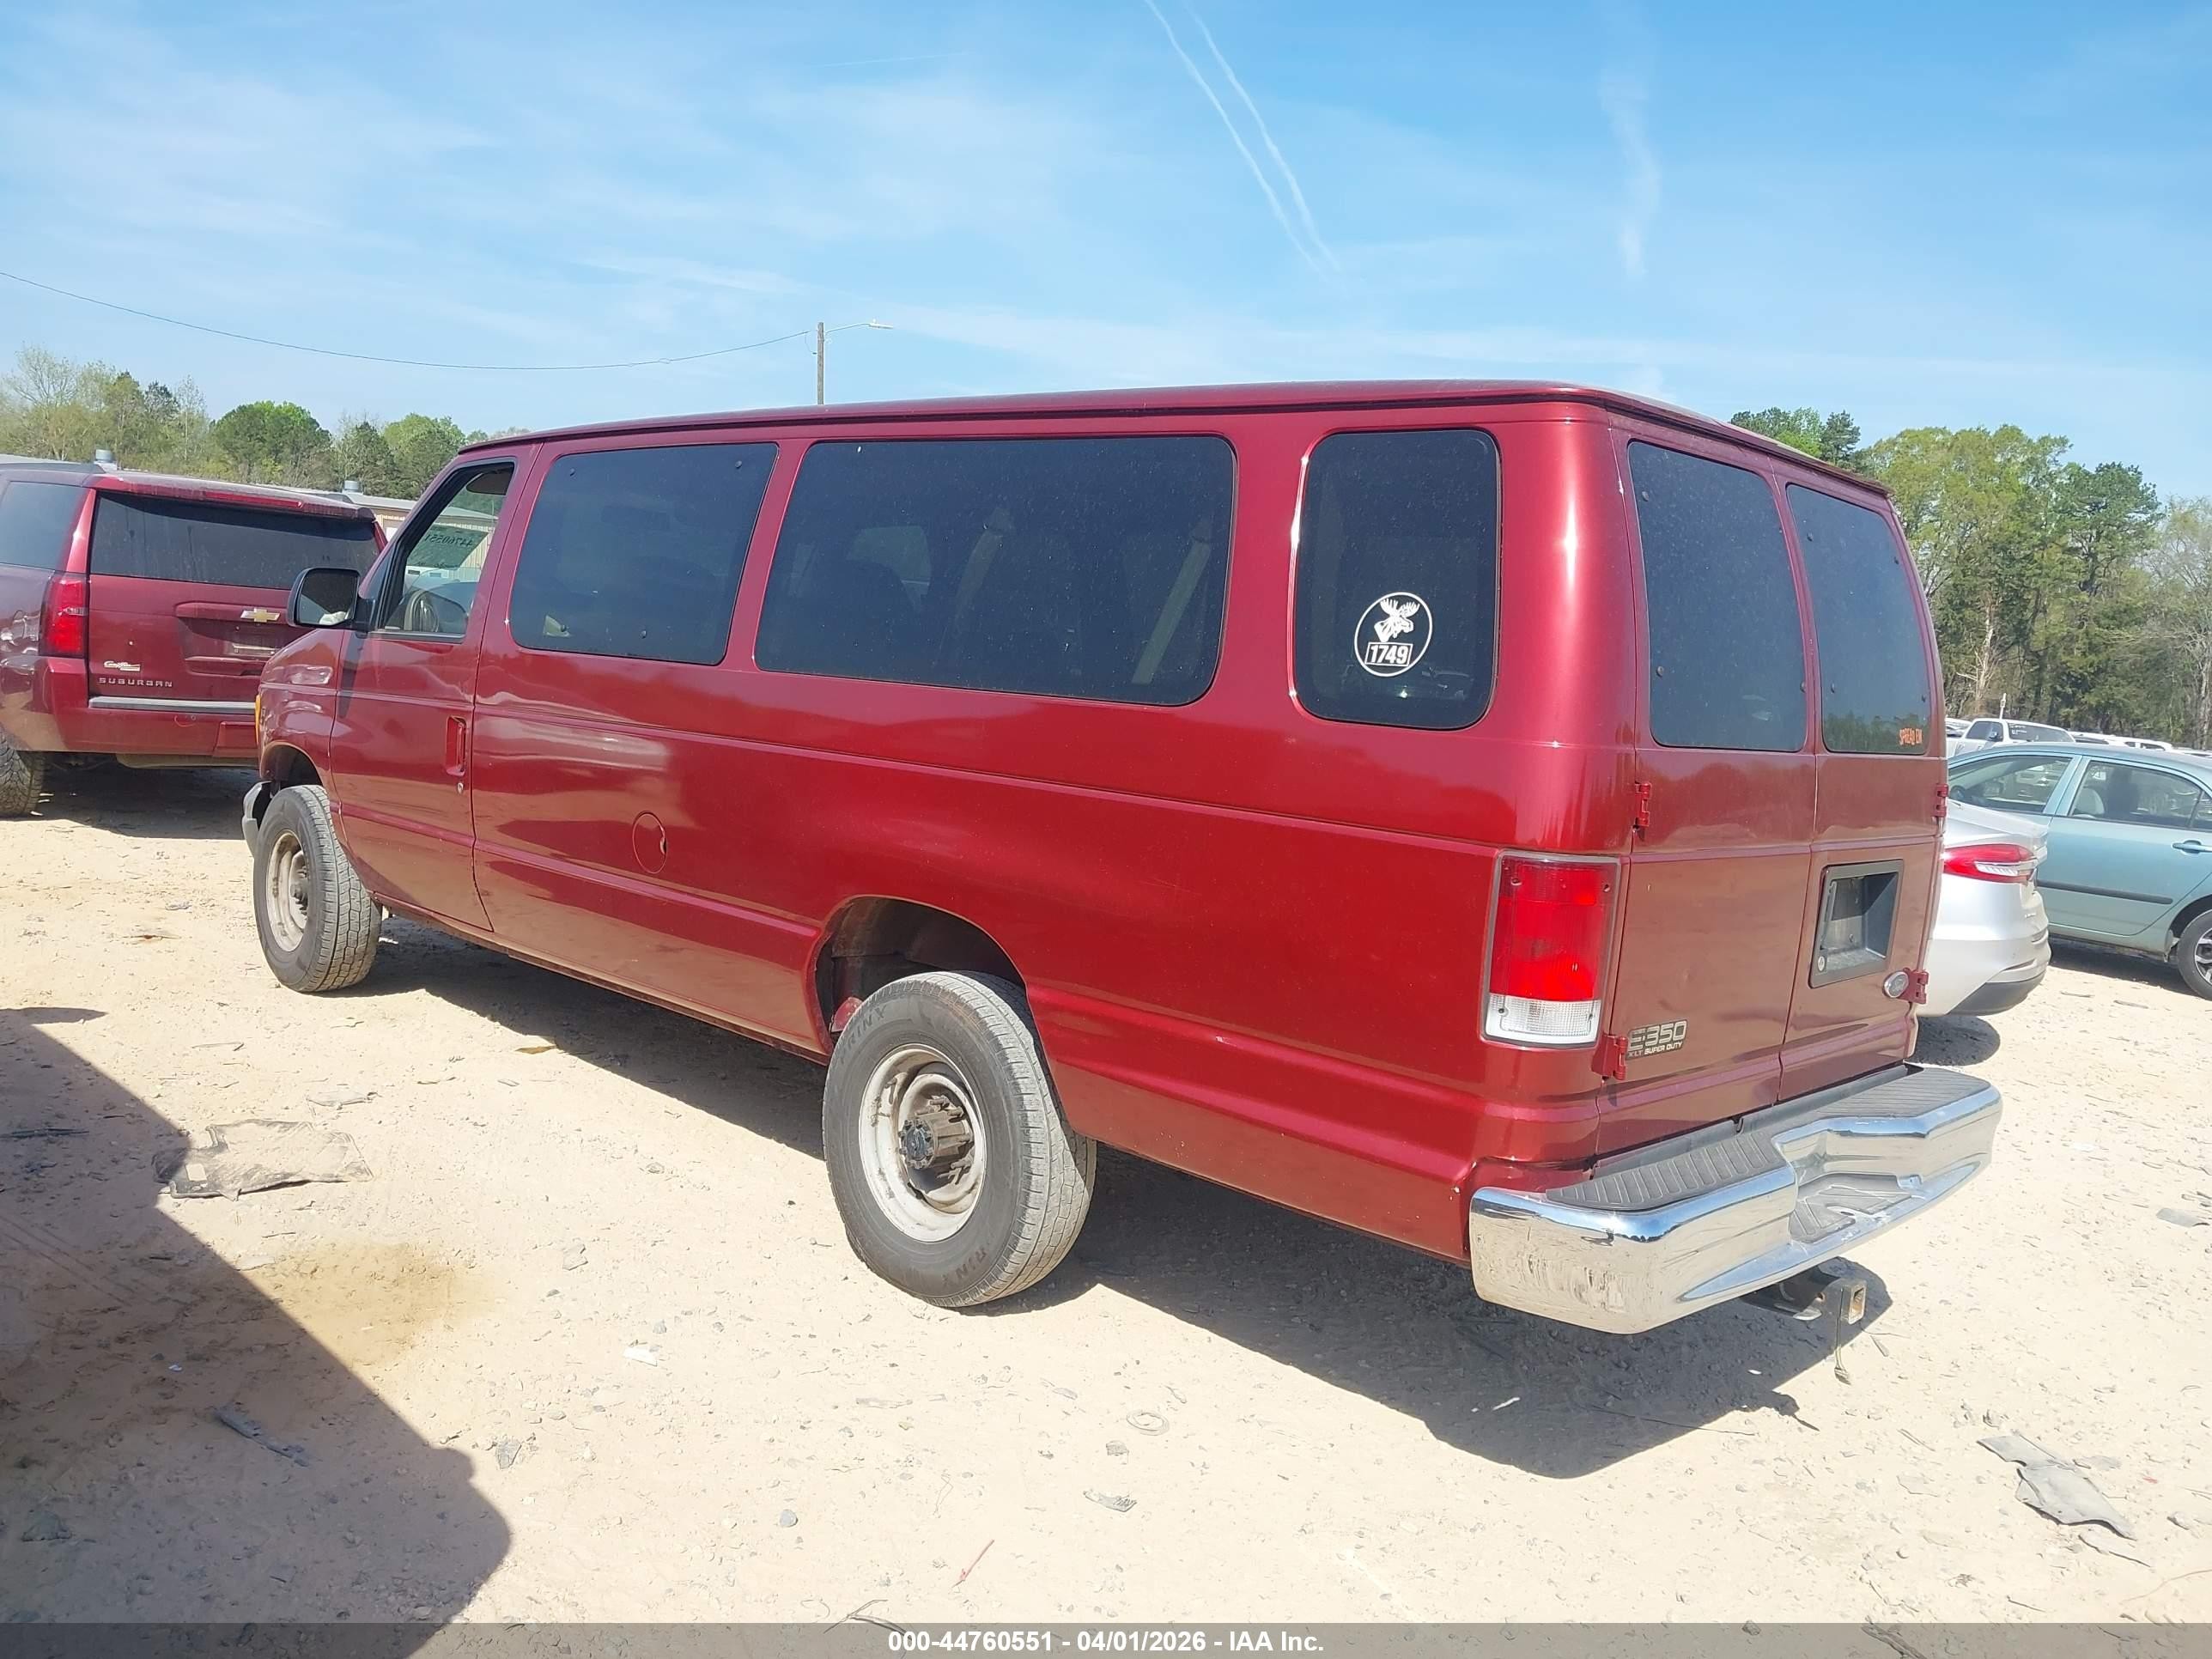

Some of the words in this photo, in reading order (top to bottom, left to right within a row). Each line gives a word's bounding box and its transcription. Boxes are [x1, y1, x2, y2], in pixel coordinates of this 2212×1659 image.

[1370, 644, 1409, 665] 1749
[99, 677, 173, 688] SUBURBAN
[1644, 1044, 1666, 1055] SUPER
[1666, 1040, 1683, 1051] DUTY
